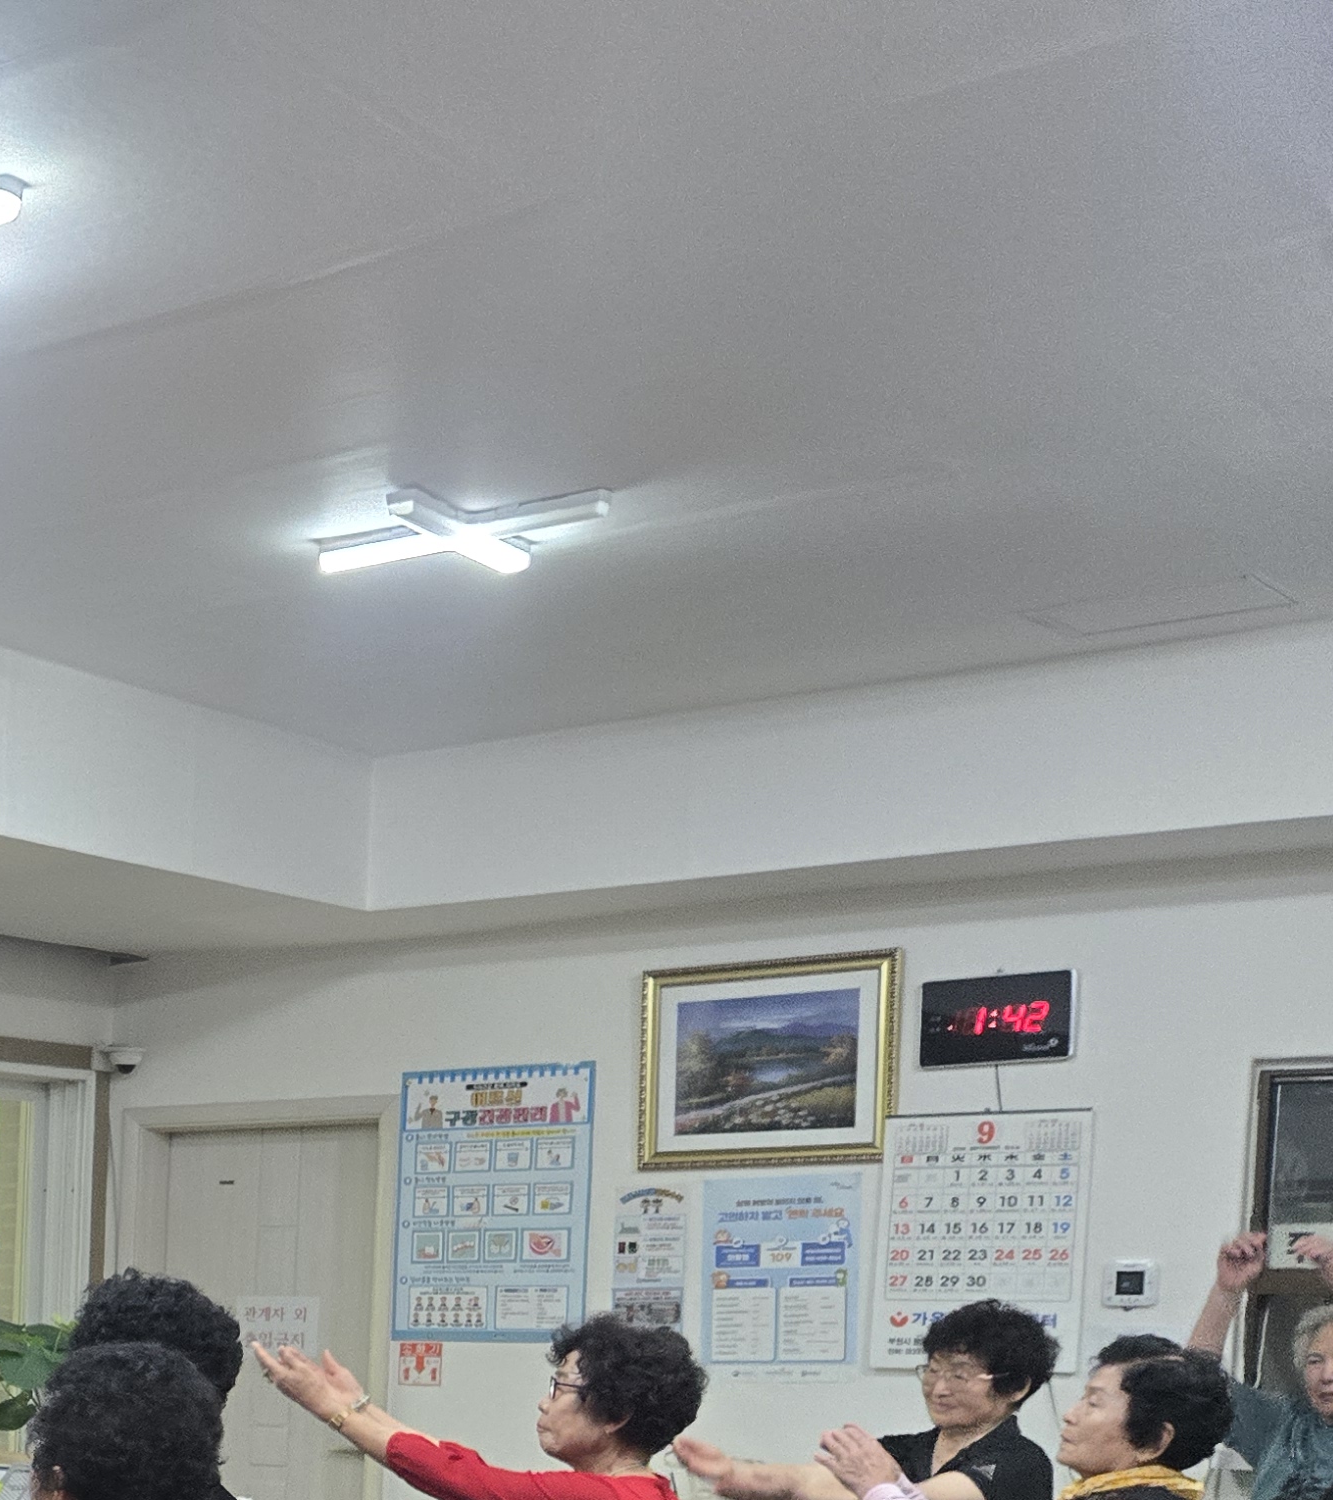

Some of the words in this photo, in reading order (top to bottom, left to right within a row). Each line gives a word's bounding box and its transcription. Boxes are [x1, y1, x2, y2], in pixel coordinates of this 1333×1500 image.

[974, 1001, 1050, 1035] 1:42
[977, 1120, 996, 1144] 9
[1058, 1152, 1073, 1161] 土
[955, 1170, 960, 1181] 1
[978, 1170, 988, 1181] 2
[1005, 1169, 1015, 1180] 3
[1032, 1168, 1043, 1180] 4
[1060, 1168, 1070, 1180] 5
[899, 1197, 909, 1209] 6
[924, 1197, 933, 1208] 7
[950, 1197, 960, 1208] 8
[976, 1196, 987, 1208] 9
[999, 1196, 1018, 1207] 10
[1028, 1195, 1045, 1206] 11
[1055, 1195, 1073, 1207] 12
[893, 1223, 910, 1235] 13
[919, 1222, 935, 1235] 14
[945, 1222, 962, 1234] 15
[971, 1222, 989, 1234] 16
[998, 1222, 1016, 1234] 17
[1025, 1222, 1043, 1233] 18
[1052, 1222, 1071, 1233] 19
[770, 1253, 792, 1262] 109
[890, 1249, 909, 1261] 20
[918, 1249, 935, 1261] 21
[942, 1249, 961, 1261] 22
[968, 1249, 987, 1261] 23
[995, 1249, 1015, 1261] 24
[1022, 1248, 1043, 1261] 25
[1049, 1249, 1070, 1261] 26
[889, 1275, 908, 1287] 27
[914, 1275, 933, 1287] 28
[940, 1275, 960, 1287] 29
[966, 1275, 986, 1287] 30
[244, 1307, 285, 1322] 관계자
[294, 1307, 307, 1323] 외
